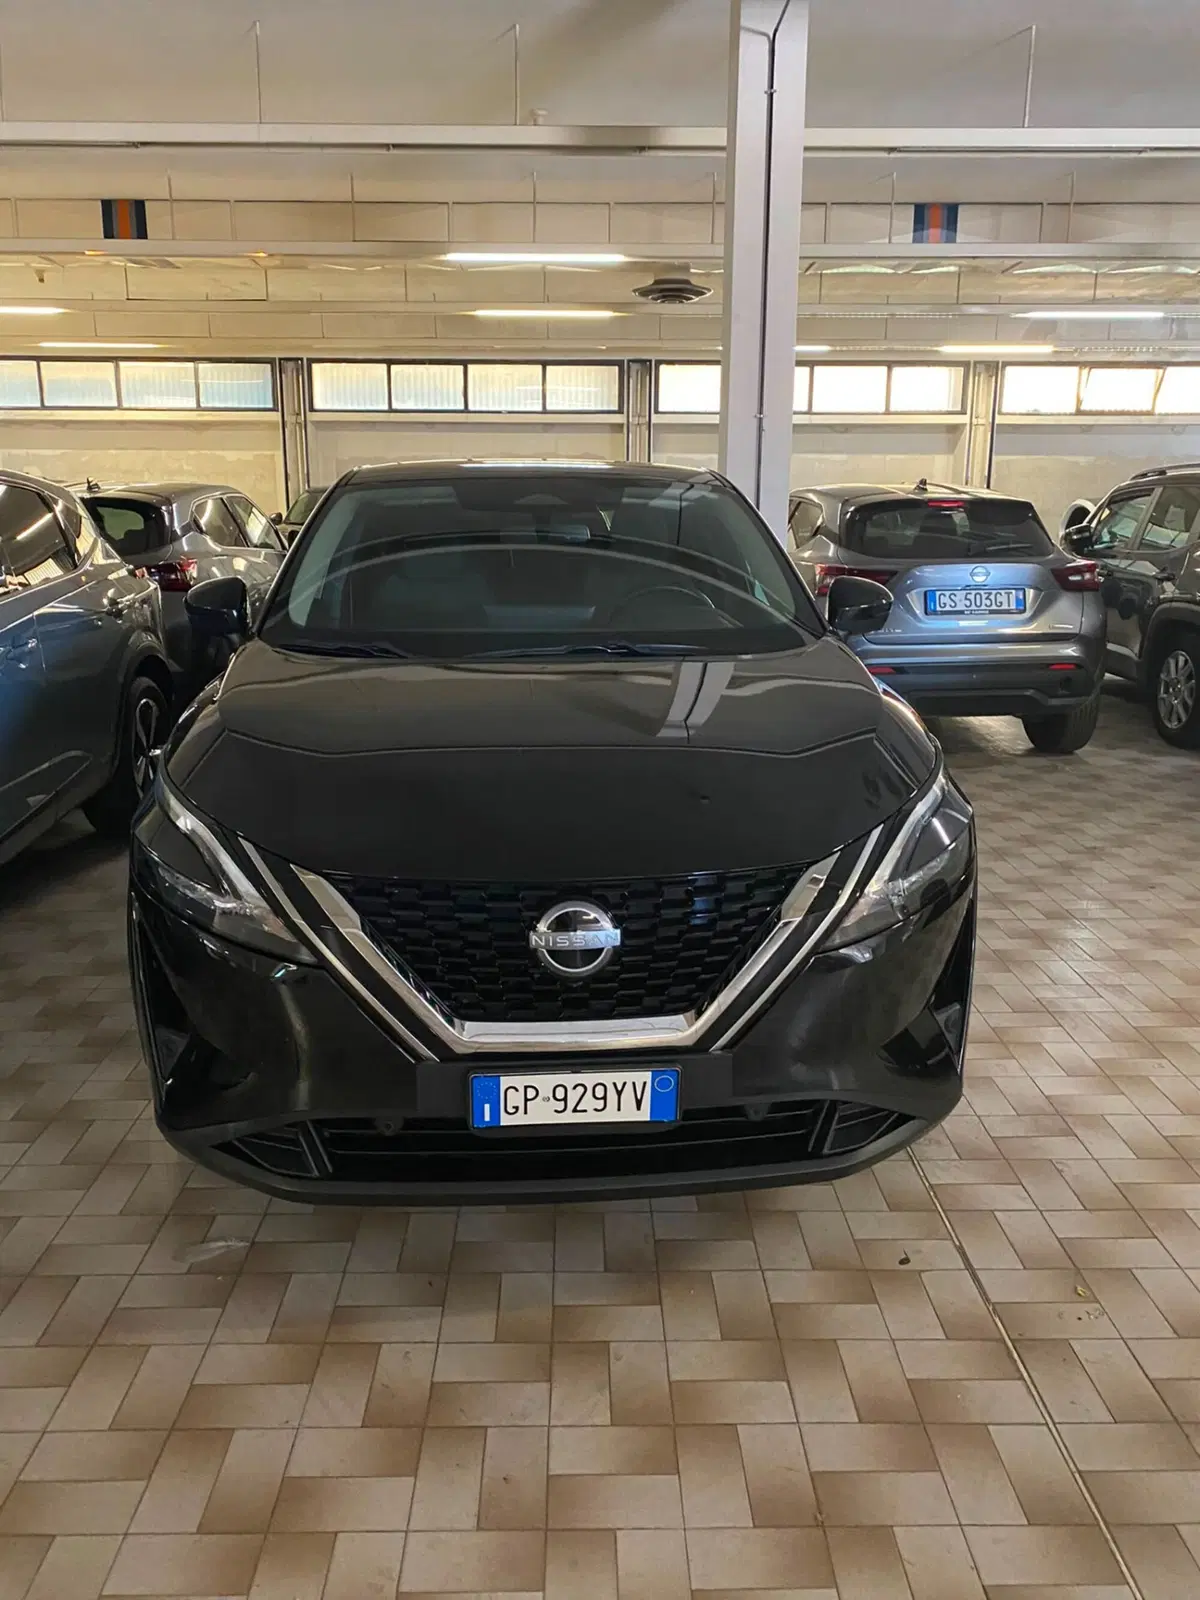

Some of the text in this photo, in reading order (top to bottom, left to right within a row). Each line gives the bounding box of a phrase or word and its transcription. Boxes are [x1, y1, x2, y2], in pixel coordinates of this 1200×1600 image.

[938, 592, 957, 609] GS
[964, 591, 1013, 608] 503GT
[531, 933, 619, 947] NISSAN
[503, 1085, 540, 1116] GP
[552, 1081, 647, 1114] 929YV
